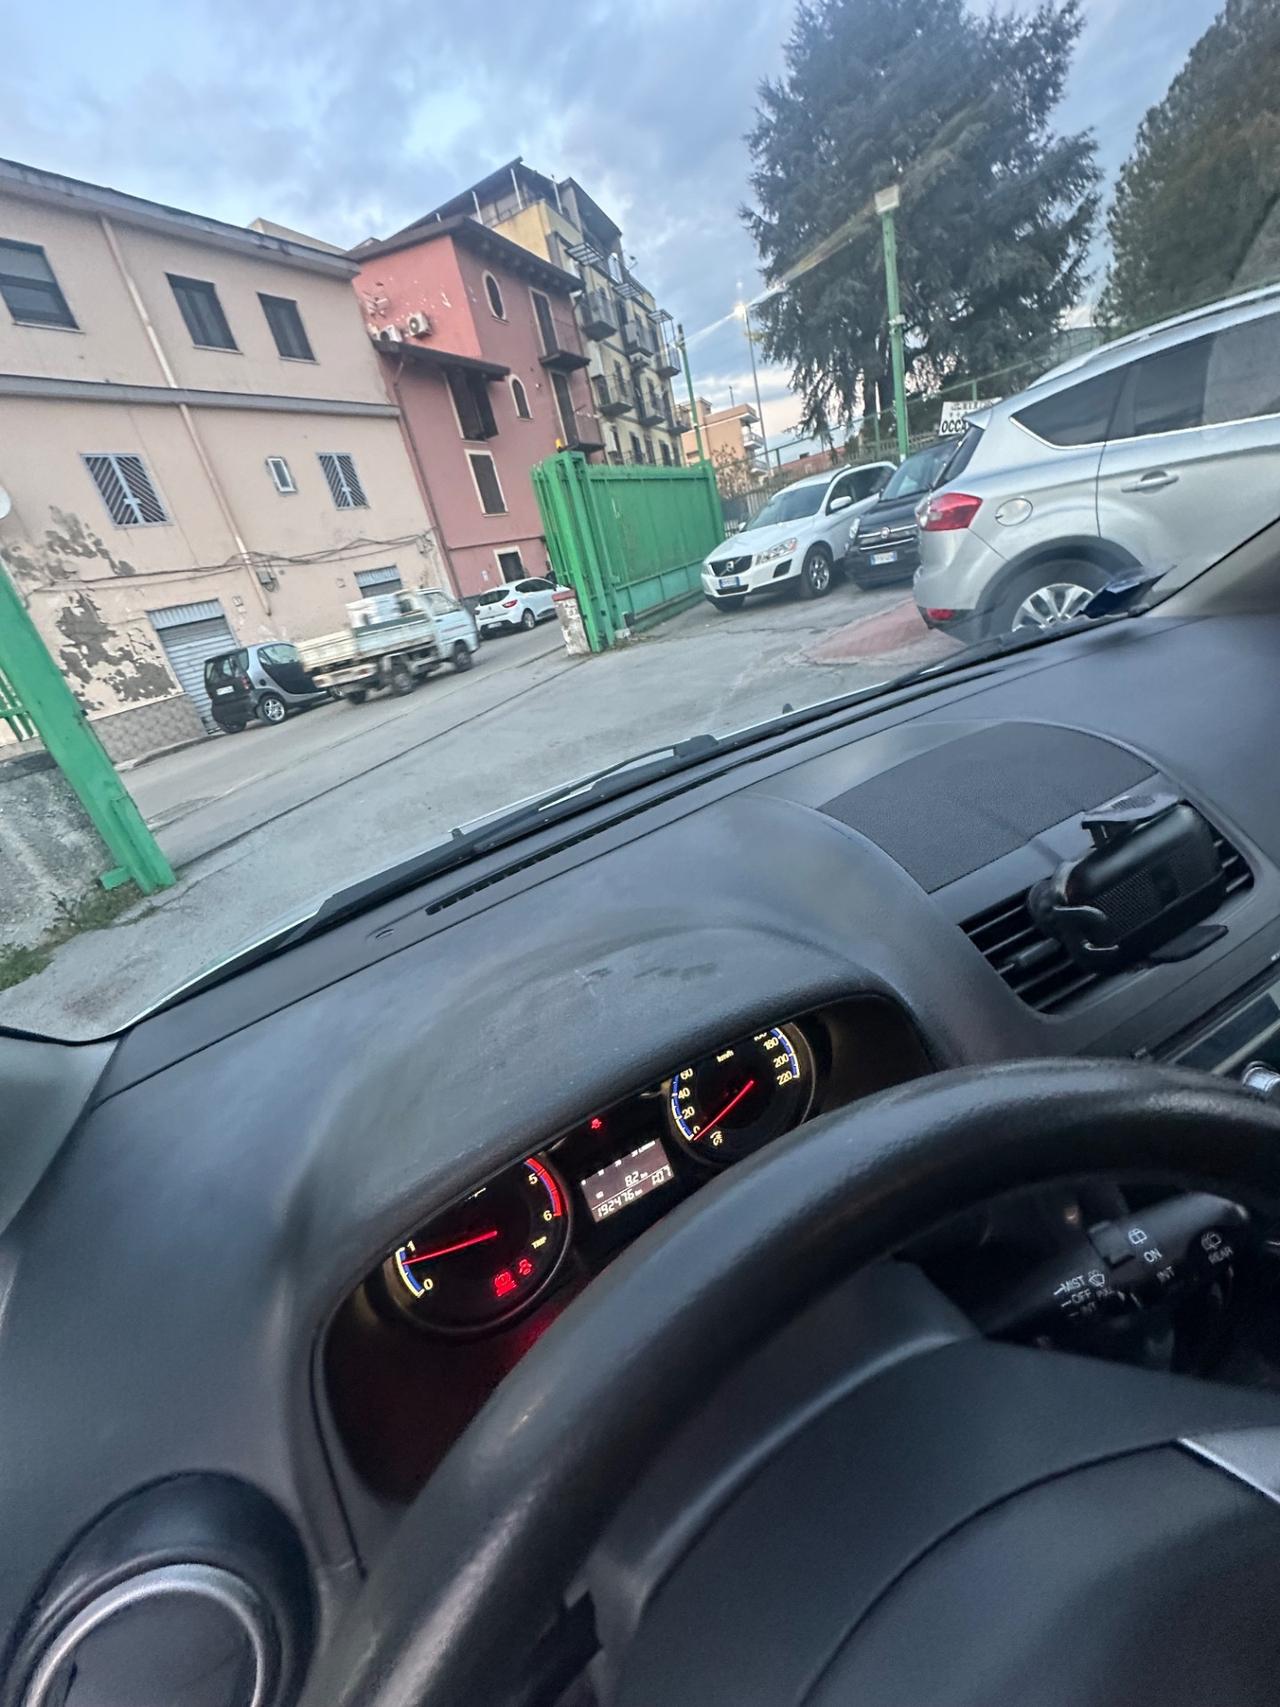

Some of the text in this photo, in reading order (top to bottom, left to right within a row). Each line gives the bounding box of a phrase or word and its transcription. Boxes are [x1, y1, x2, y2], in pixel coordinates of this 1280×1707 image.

[763, 1037, 779, 1050] 180
[773, 1053, 789, 1068] 200
[680, 1068, 694, 1080] 60
[776, 1070, 792, 1085] 220
[678, 1087, 691, 1099] 40
[682, 1106, 695, 1119] 20
[528, 1173, 538, 1185] 5
[597, 1188, 635, 1217] 192476
[543, 1209, 553, 1221] 6
[407, 1240, 416, 1252] 1
[1143, 1247, 1163, 1263] ON
[1207, 1246, 1233, 1264] REAR
[1156, 1266, 1175, 1283] INT
[423, 1278, 434, 1291] 0
[1061, 1274, 1085, 1293] MIST
[1070, 1288, 1092, 1304] OFF
